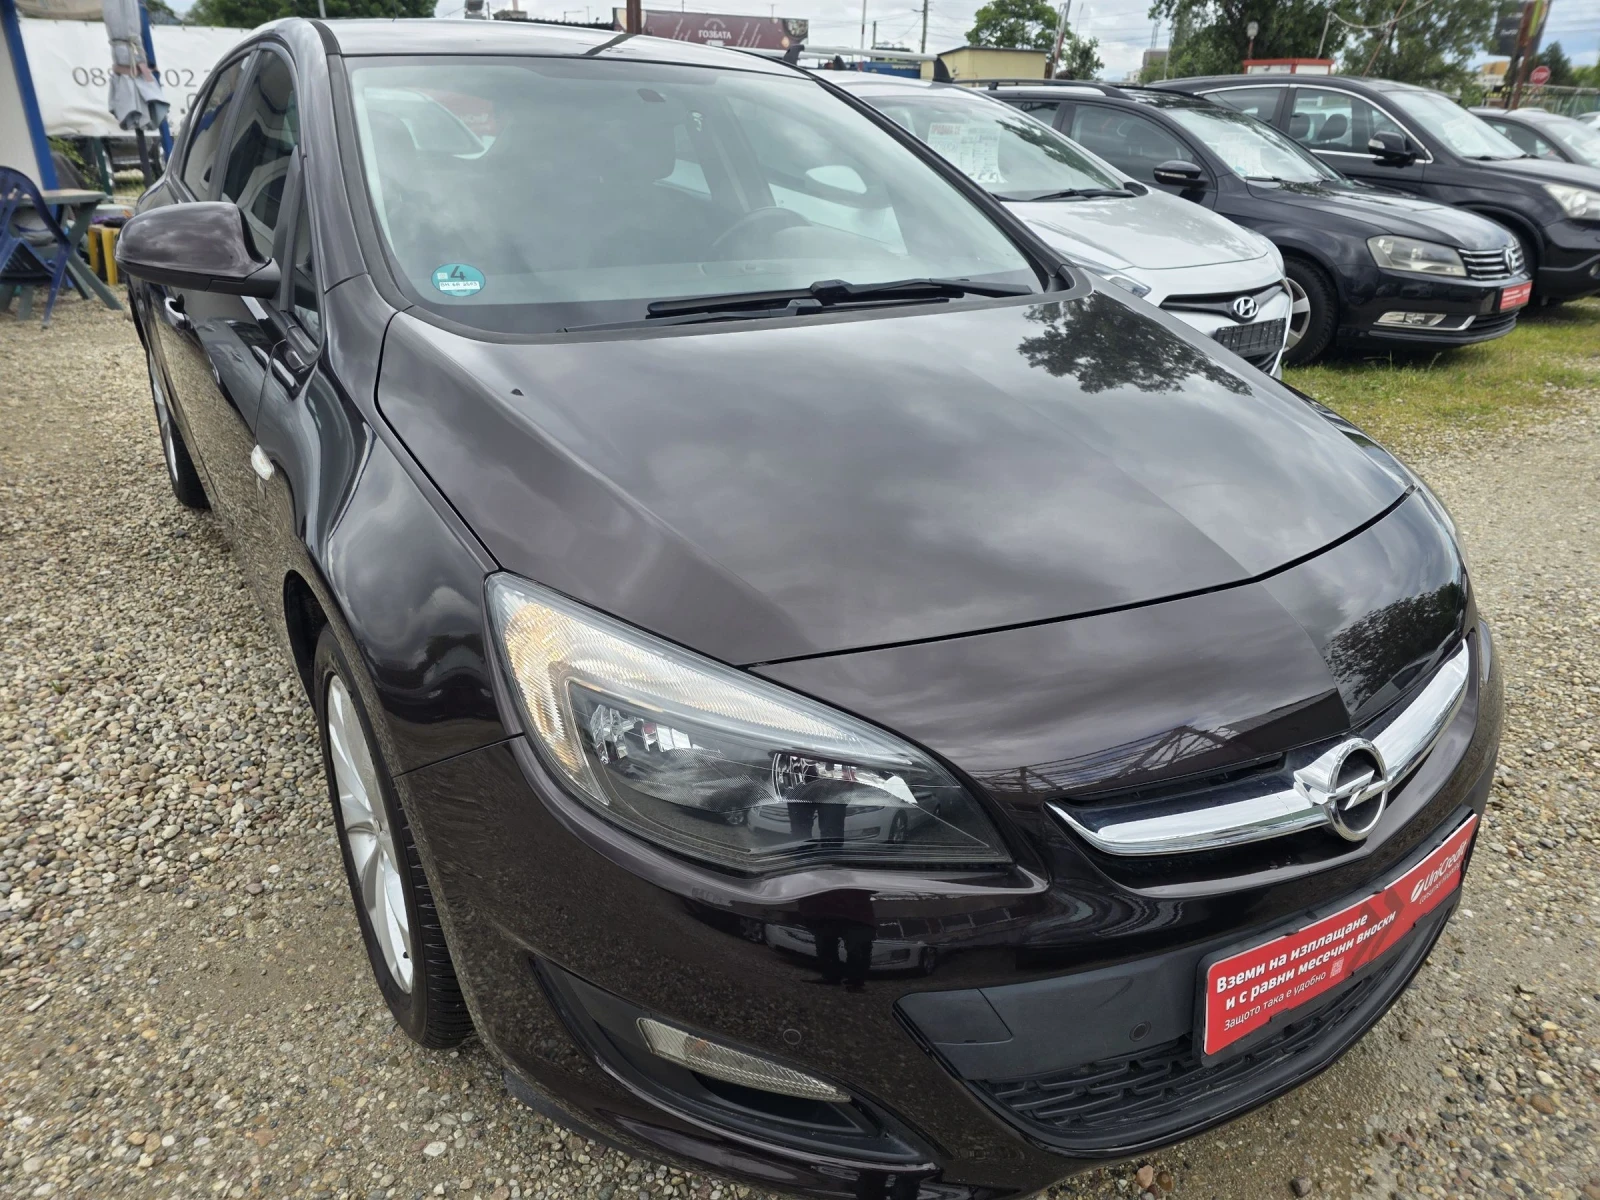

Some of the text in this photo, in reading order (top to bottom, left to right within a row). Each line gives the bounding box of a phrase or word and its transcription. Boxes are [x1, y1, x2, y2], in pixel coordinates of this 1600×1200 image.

[698, 29, 732, 39] ГОЗБАТА
[450, 265, 466, 280] 4
[1216, 914, 1368, 993] Вземи на изплащане
[1225, 911, 1396, 1010] и с равни месечни вноски
[1224, 972, 1326, 1031] Защото така е удобно
